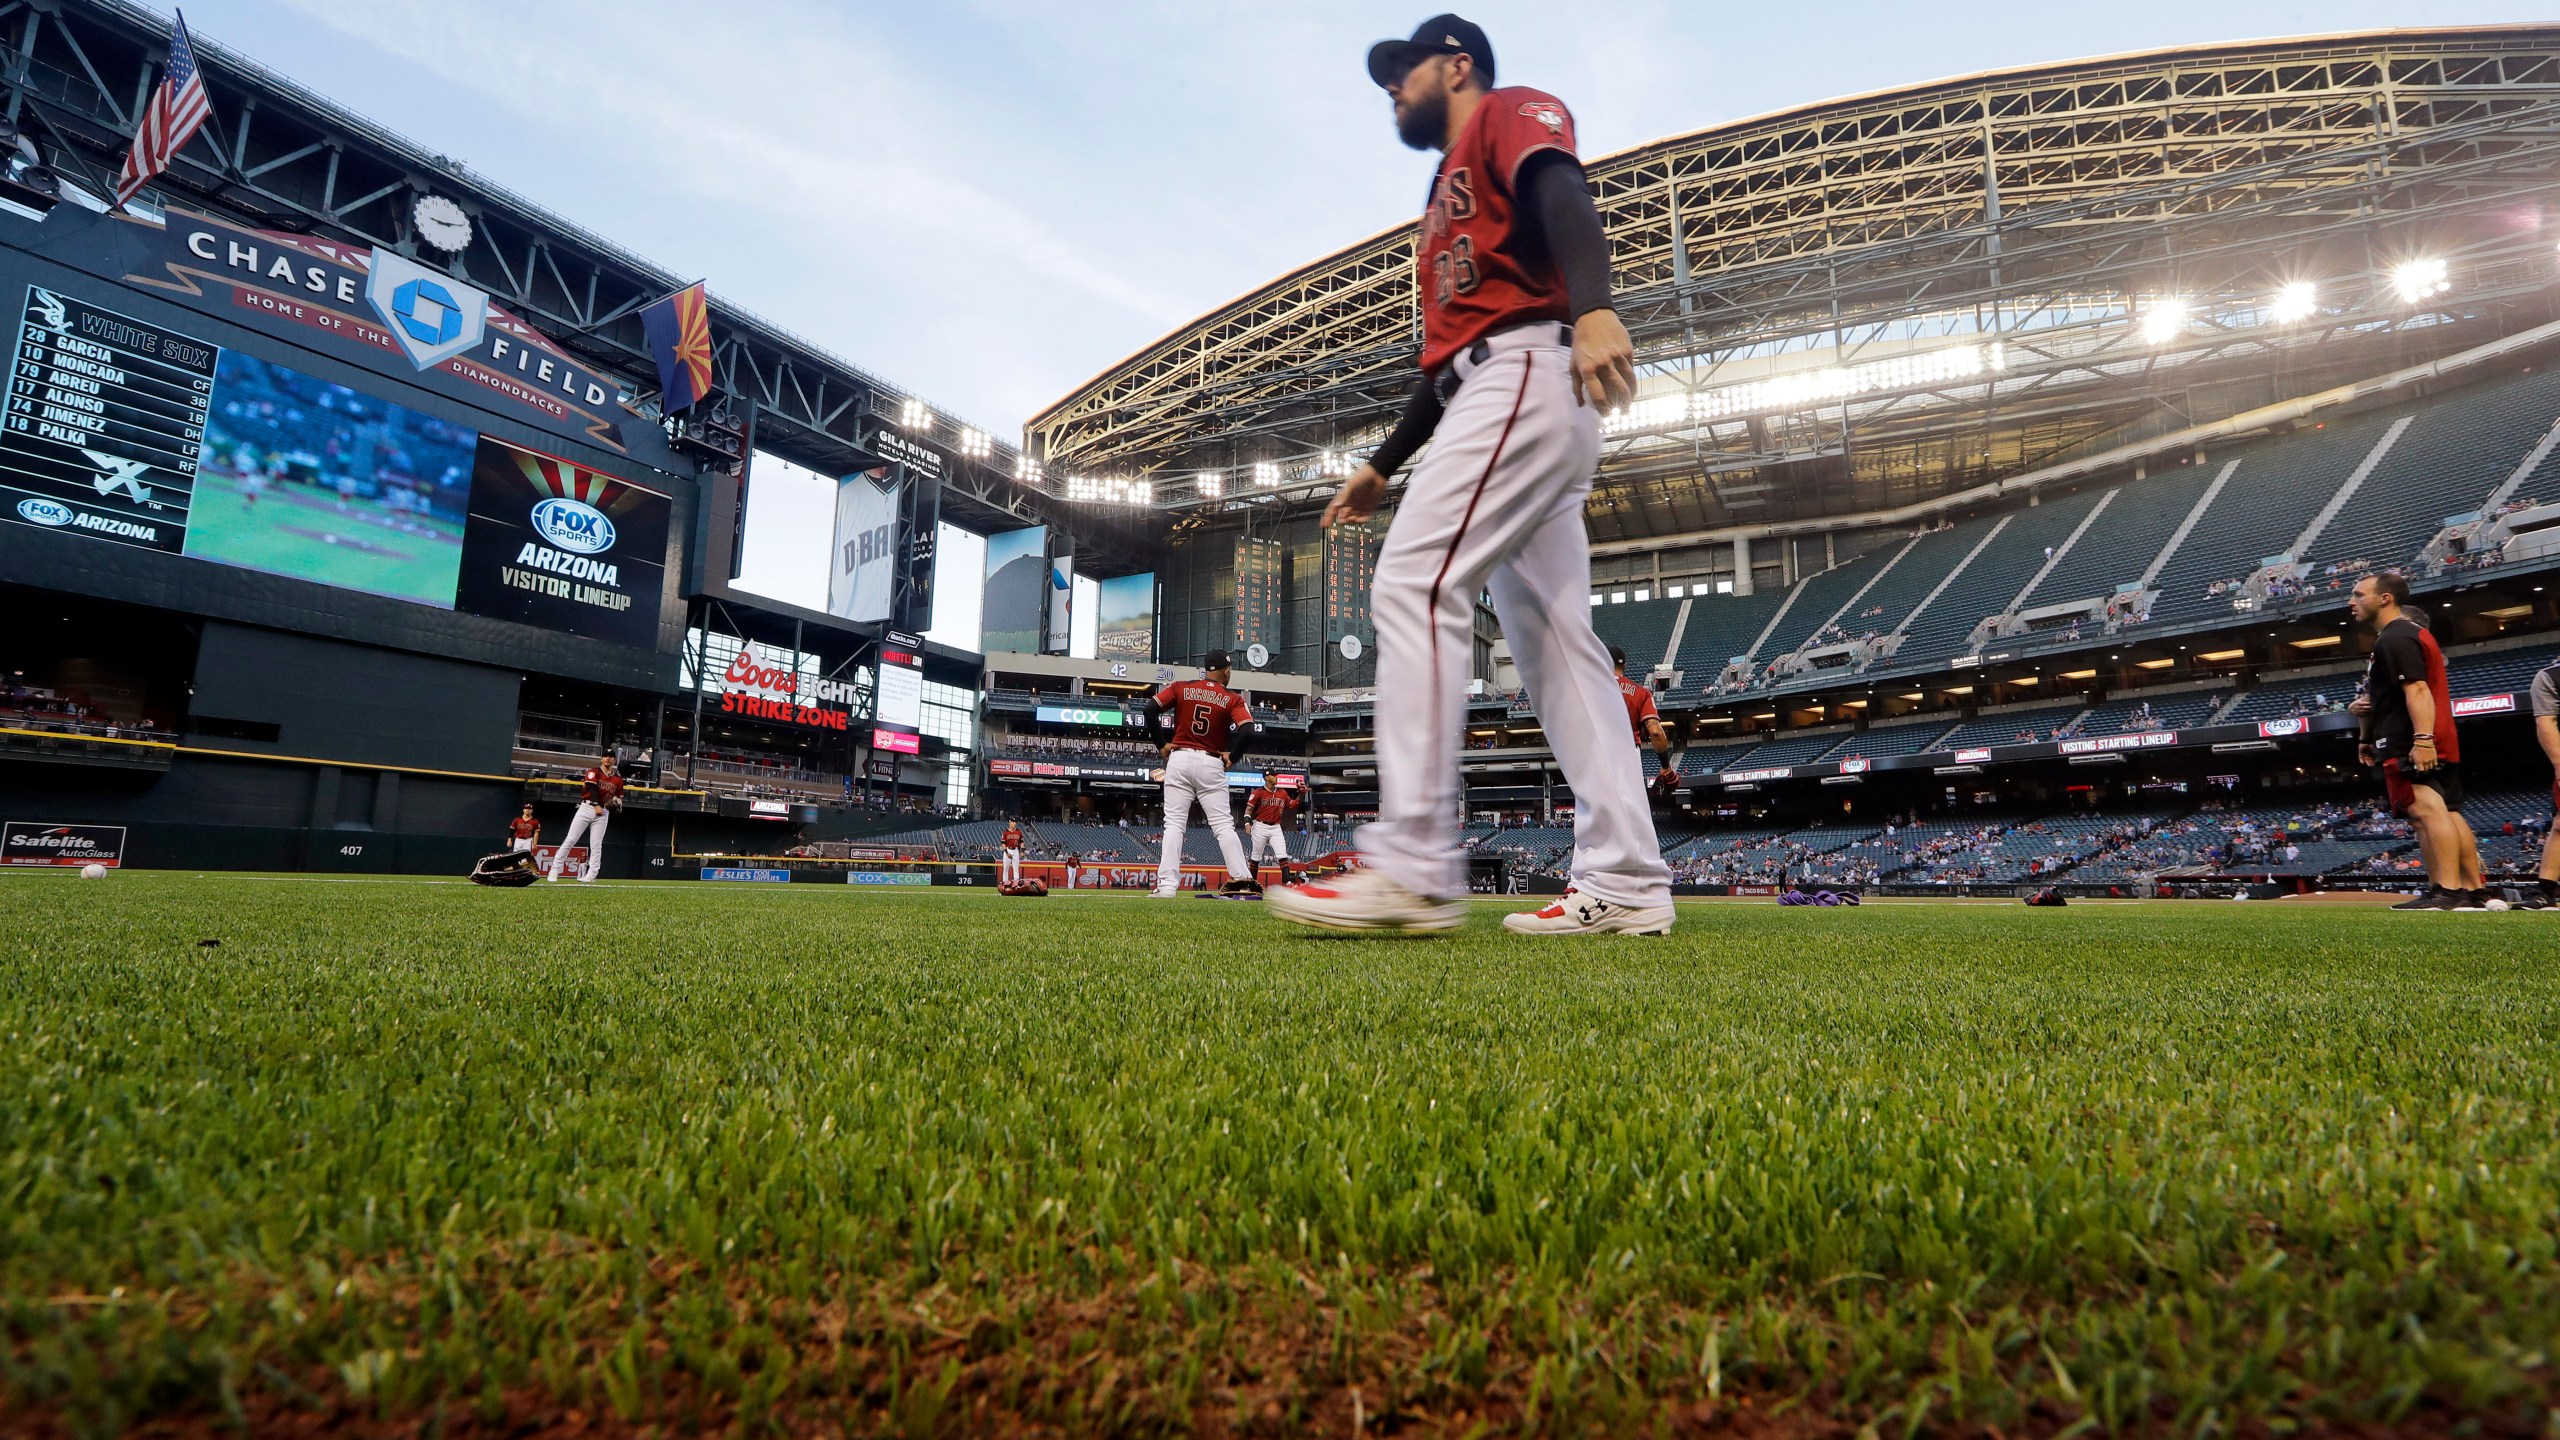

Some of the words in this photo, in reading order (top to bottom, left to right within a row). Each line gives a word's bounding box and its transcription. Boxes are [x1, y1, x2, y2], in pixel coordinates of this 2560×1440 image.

[187, 232, 356, 304] CHASE
[491, 337, 606, 406] FIELD
[82, 312, 158, 353] WHITE
[162, 339, 210, 369] SOX
[26, 327, 46, 343] 28
[56, 335, 112, 363] GARCIA
[192, 380, 211, 392] CF
[246, 293, 304, 319] HOME
[318, 315, 342, 330] OF
[356, 326, 390, 347] THE
[452, 361, 562, 415] DIAMONDBACKS
[24, 345, 43, 360] 10
[53, 352, 125, 385] MONCADA
[190, 396, 207, 408] 3B
[20, 362, 40, 378] 79
[49, 370, 101, 395] ABREU
[188, 412, 204, 424] 1B
[18, 380, 36, 395] 17
[46, 388, 104, 414] ALONSO
[184, 428, 202, 440] DH
[12, 398, 32, 414] 74
[41, 405, 107, 433] JIMENEZ
[182, 444, 199, 456] LF
[9, 416, 28, 431] 18
[38, 422, 87, 446] PALKA
[178, 460, 196, 473] RF
[878, 430, 906, 452] GILA
[908, 442, 940, 466] RIVER
[878, 442, 904, 458] HOTELS
[912, 458, 940, 473] CASINOS
[29, 512, 61, 522] SPORTS
[30, 501, 61, 518] FOX
[72, 512, 157, 542] ARIZONA
[551, 506, 598, 538] FOX
[550, 526, 598, 546] SPORTS
[516, 542, 620, 588] ARIZONA
[501, 566, 571, 599] VISITOR
[574, 584, 632, 612] LINEUP
[1100, 634, 1148, 651] Slugger
[912, 655, 923, 668] ON
[725, 652, 798, 694] Coors
[800, 676, 857, 705] LIGHT
[1110, 664, 1127, 678] 42
[1156, 668, 1175, 680] 20
[1184, 688, 1230, 709] ESCOBAR
[2454, 697, 2512, 713] ARIZONA
[721, 692, 794, 722] STRIKE
[795, 705, 848, 731] ZONE
[1060, 708, 1100, 724] COX
[1190, 704, 1212, 736] 5
[2272, 719, 2293, 729] FOX
[1006, 734, 1026, 746] THE
[1028, 736, 1058, 748] DRAFT
[1060, 738, 1088, 750] ROOM
[1104, 740, 1134, 752] CRAFT
[2061, 740, 2096, 753] VISITING
[2098, 737, 2140, 750] STARTING
[2142, 734, 2174, 746] LINEUP
[1957, 751, 1989, 760] ARIZONA
[1064, 766, 1080, 776] DOG
[1137, 768, 1150, 780] $1
[1722, 773, 1744, 782] VISITING
[1744, 771, 1770, 780] STARTING
[1770, 769, 1790, 778] LINEUP
[753, 801, 787, 812] ARIZONA
[10, 834, 95, 849] Safelite
[340, 845, 363, 856] 407
[57, 848, 116, 858] AutoGlass
[651, 858, 664, 866] 413
[852, 850, 892, 858] dbacks.com
[715, 870, 751, 880] LESLIE'S
[858, 874, 883, 882] COX
[897, 875, 922, 883] COX
[1110, 868, 1158, 887] State
